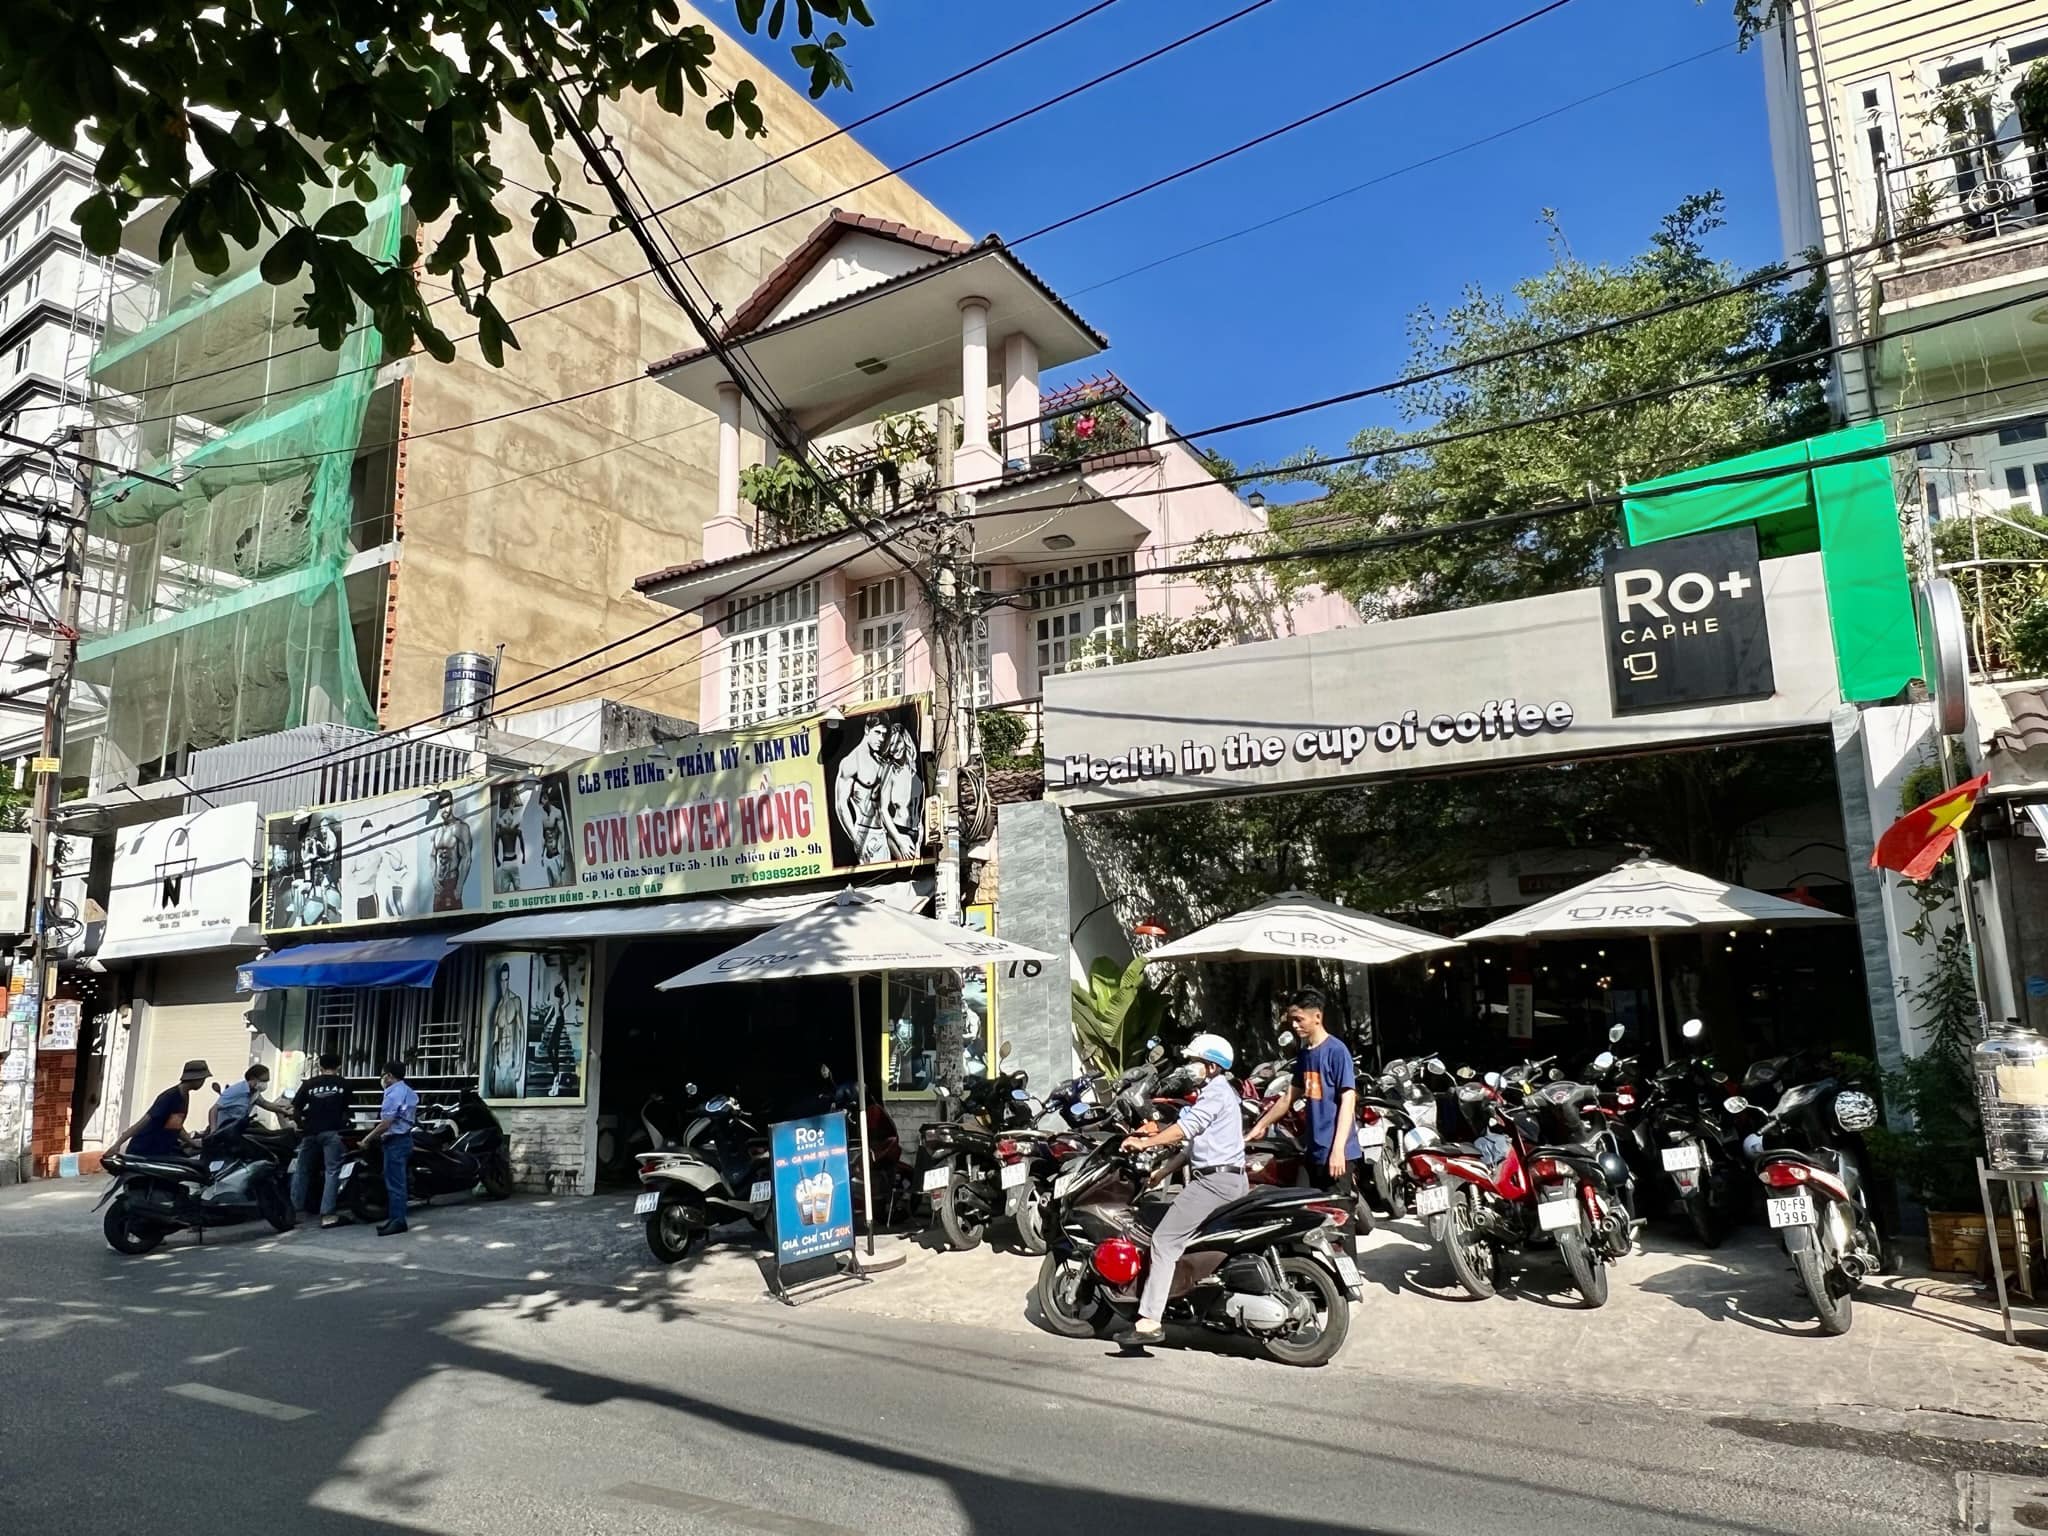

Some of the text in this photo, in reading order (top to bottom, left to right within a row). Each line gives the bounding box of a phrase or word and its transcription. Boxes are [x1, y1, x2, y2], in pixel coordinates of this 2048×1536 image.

[1614, 568, 1752, 623] Ro+
[1621, 618, 1720, 644] CAPHE
[1064, 698, 1574, 785] Health in the cup of coffee
[578, 772, 601, 795] CLB
[755, 737, 785, 765] NAM
[583, 815, 630, 866] GYM
[738, 773, 811, 846] HỒNG
[783, 846, 798, 858] 2h
[807, 842, 822, 855] 9h
[752, 864, 821, 882] 0938923212
[162, 874, 183, 910] N
[1301, 932, 1348, 945] Ro+
[1773, 1198, 1806, 1212] 70-F9
[1775, 1211, 1808, 1225] 1396
